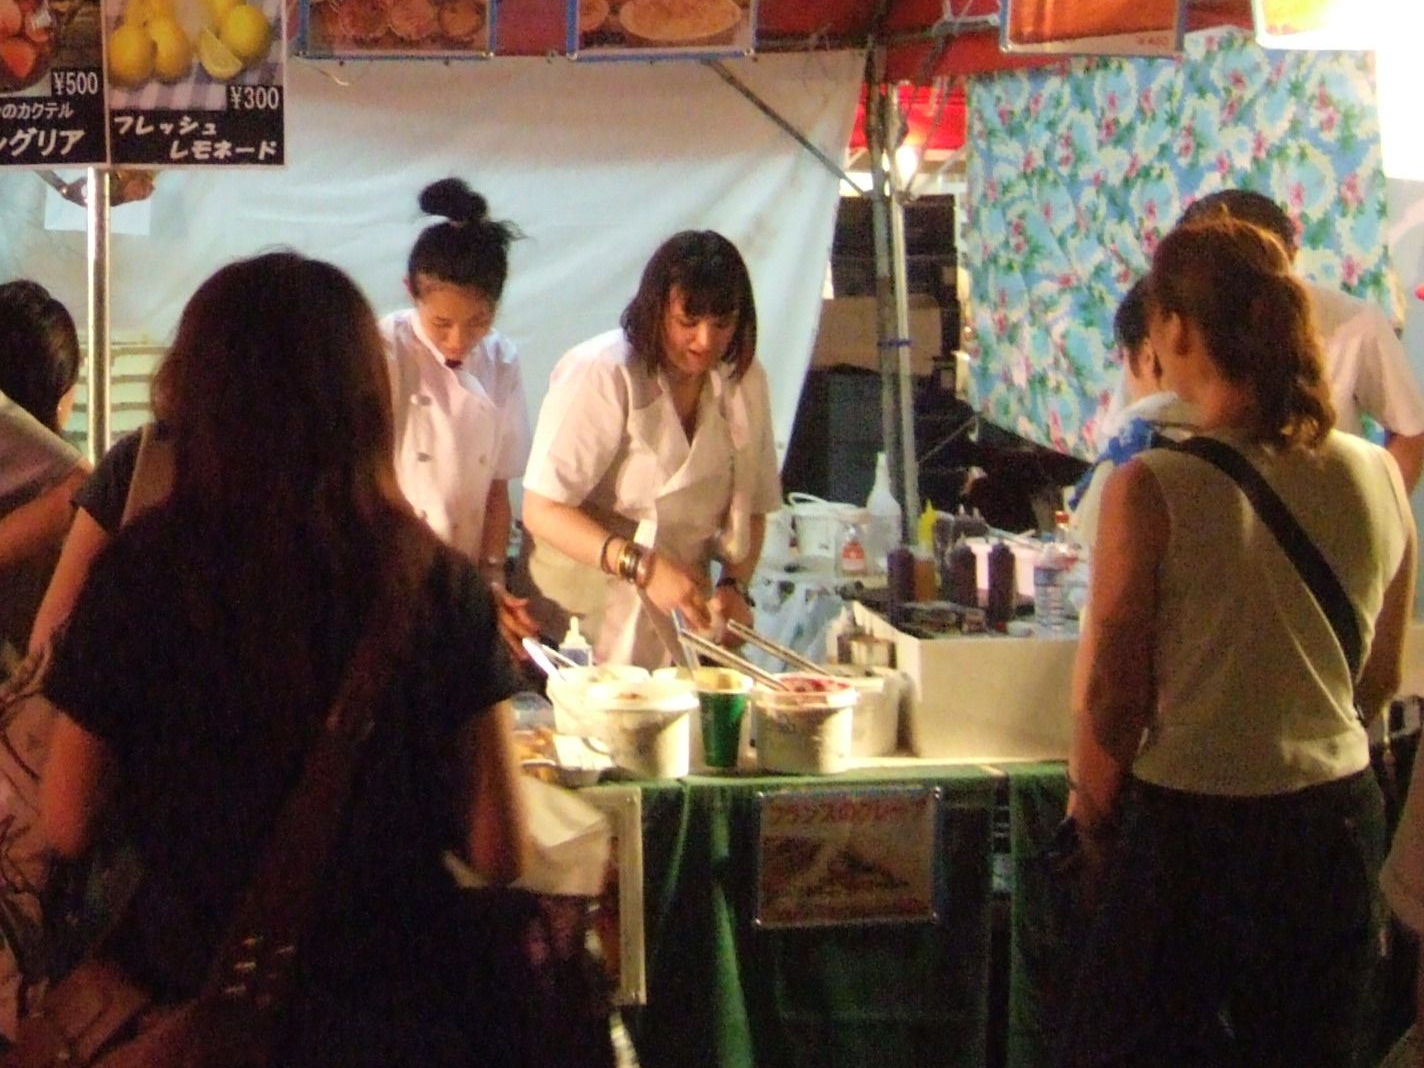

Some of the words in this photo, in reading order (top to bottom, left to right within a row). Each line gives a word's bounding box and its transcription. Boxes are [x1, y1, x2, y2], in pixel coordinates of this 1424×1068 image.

[53, 71, 99, 96] ¥500
[229, 86, 280, 110] ¥300
[113, 115, 218, 136] フレッシュ
[168, 139, 278, 160] レモネード
